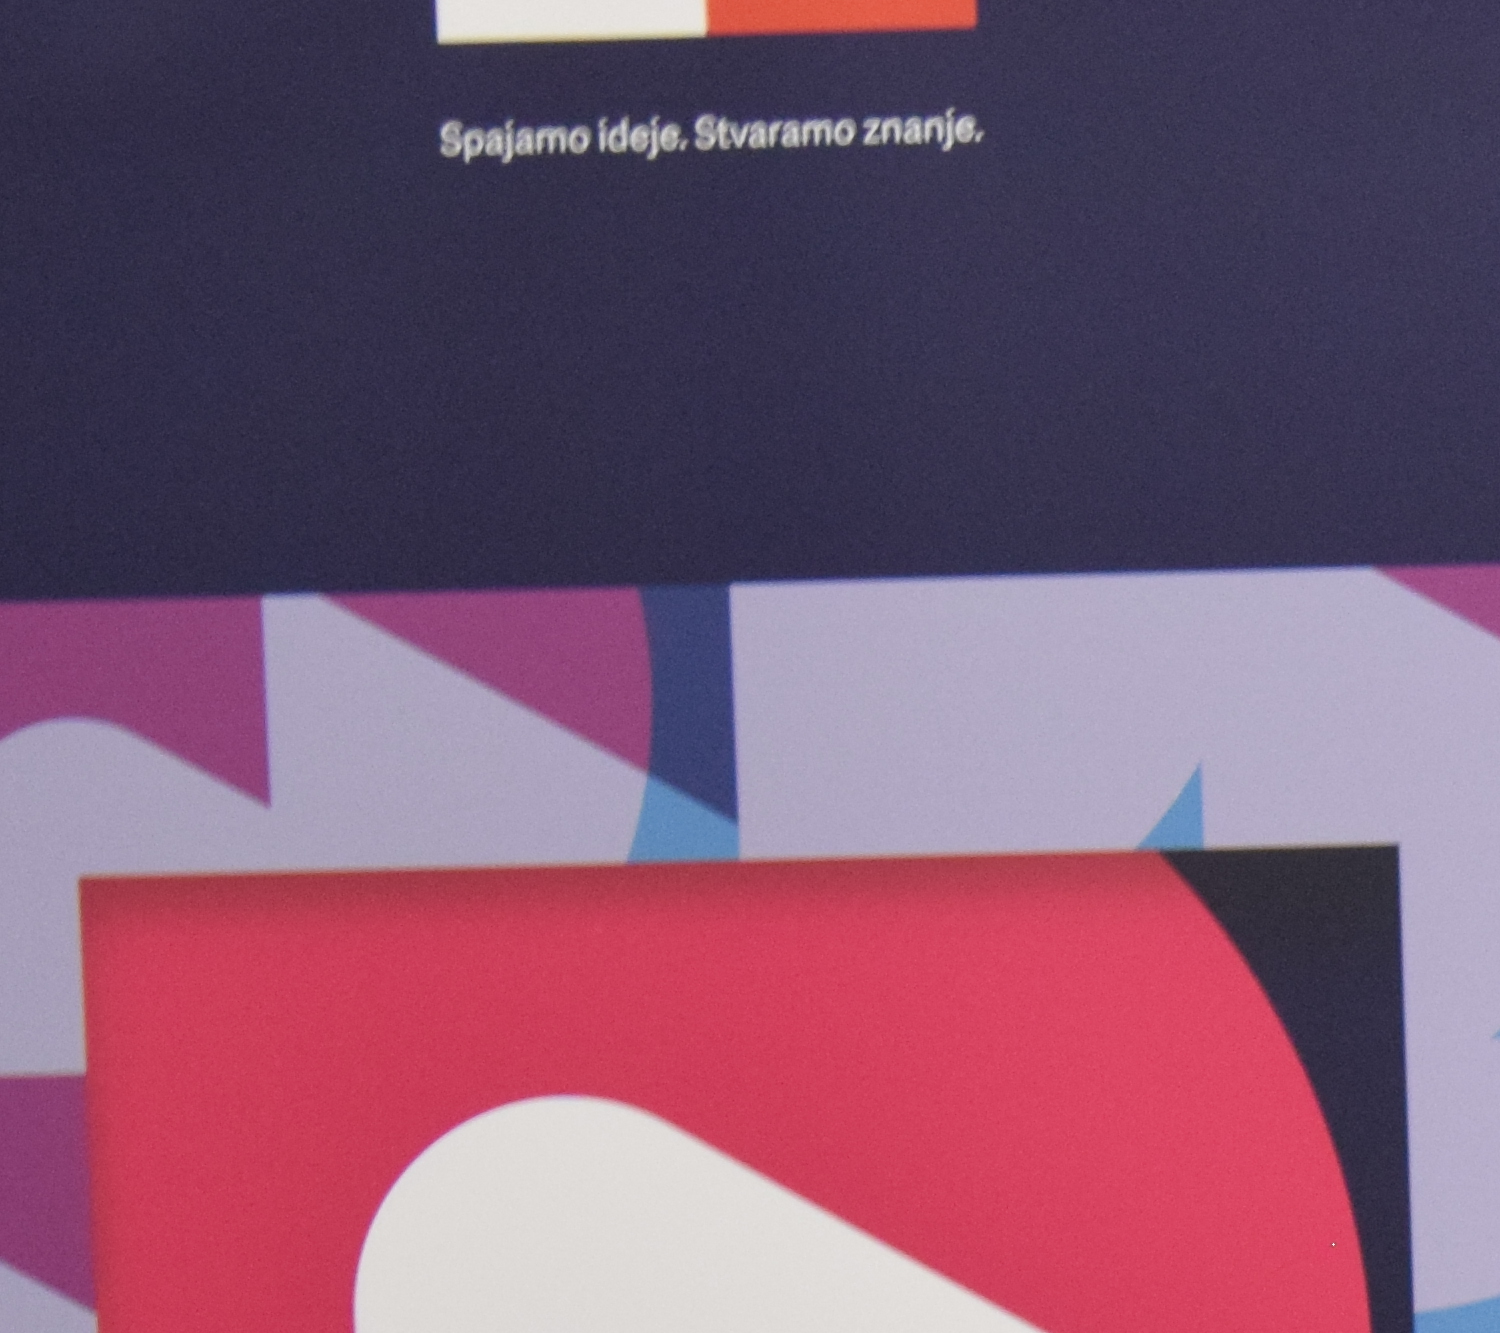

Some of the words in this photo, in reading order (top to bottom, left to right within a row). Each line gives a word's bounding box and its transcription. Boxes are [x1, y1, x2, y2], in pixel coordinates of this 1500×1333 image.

[439, 118, 592, 163] Spajamo
[597, 115, 688, 160] ideje.
[693, 112, 857, 151] Stvaramo
[862, 107, 986, 152] znanje.
